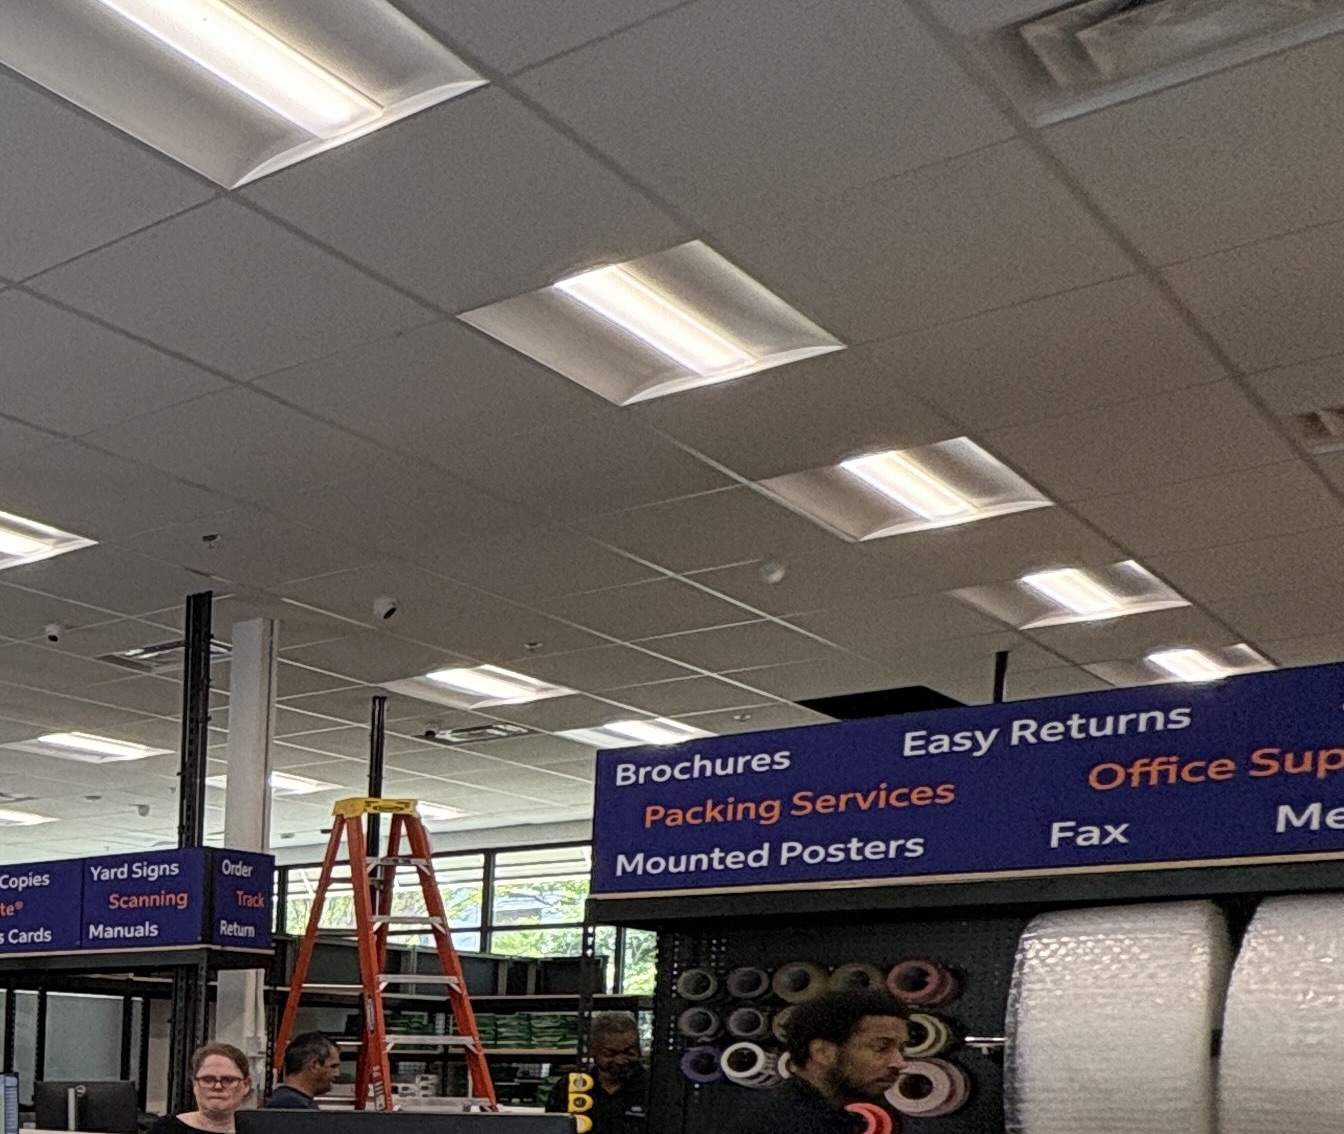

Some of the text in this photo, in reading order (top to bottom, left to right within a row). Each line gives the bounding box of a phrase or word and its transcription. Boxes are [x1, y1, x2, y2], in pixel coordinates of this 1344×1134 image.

[902, 705, 1193, 759] Easy Returns
[615, 750, 791, 788] Brochures
[1088, 748, 1344, 792] Office Sup
[644, 780, 956, 830] Packing Services
[1050, 821, 1129, 849] Fax
[615, 834, 926, 878] Mounted Posters
[90, 861, 180, 882] Yard Signs
[221, 860, 253, 879] Order
[108, 891, 189, 912] Scanning
[236, 890, 265, 908] Track
[8, 927, 52, 945] Cards
[89, 921, 159, 940] Manuals
[219, 920, 256, 939] Return
